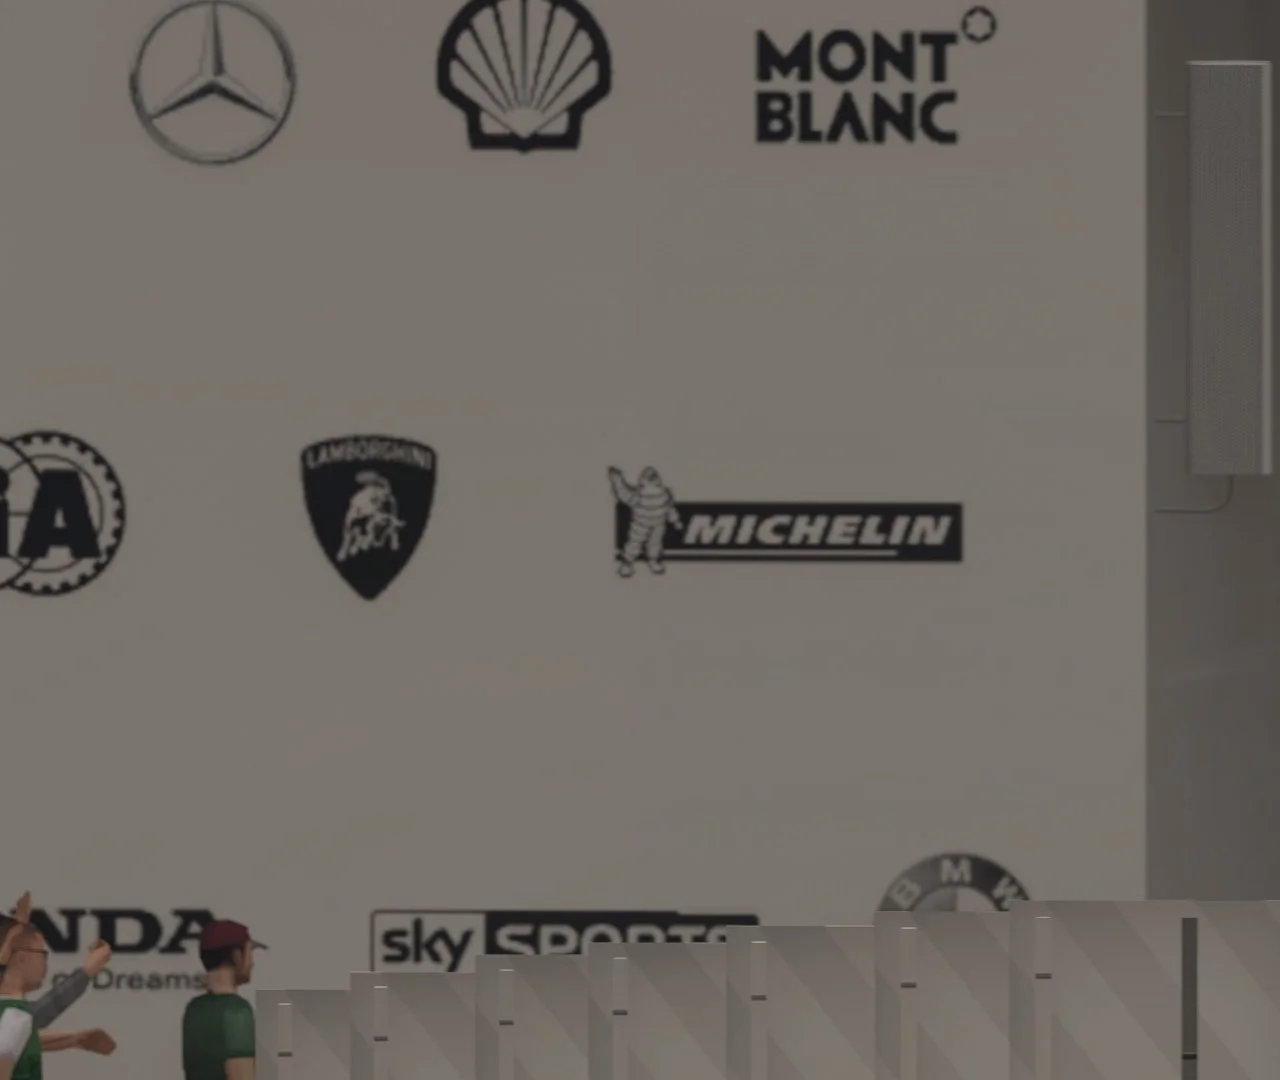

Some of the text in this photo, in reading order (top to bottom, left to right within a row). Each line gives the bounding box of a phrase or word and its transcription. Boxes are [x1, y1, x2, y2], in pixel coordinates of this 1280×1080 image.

[756, 29, 958, 83] MONT
[756, 91, 958, 143] BLANC
[683, 514, 952, 545] MICHELIN
[381, 917, 475, 973] sky
